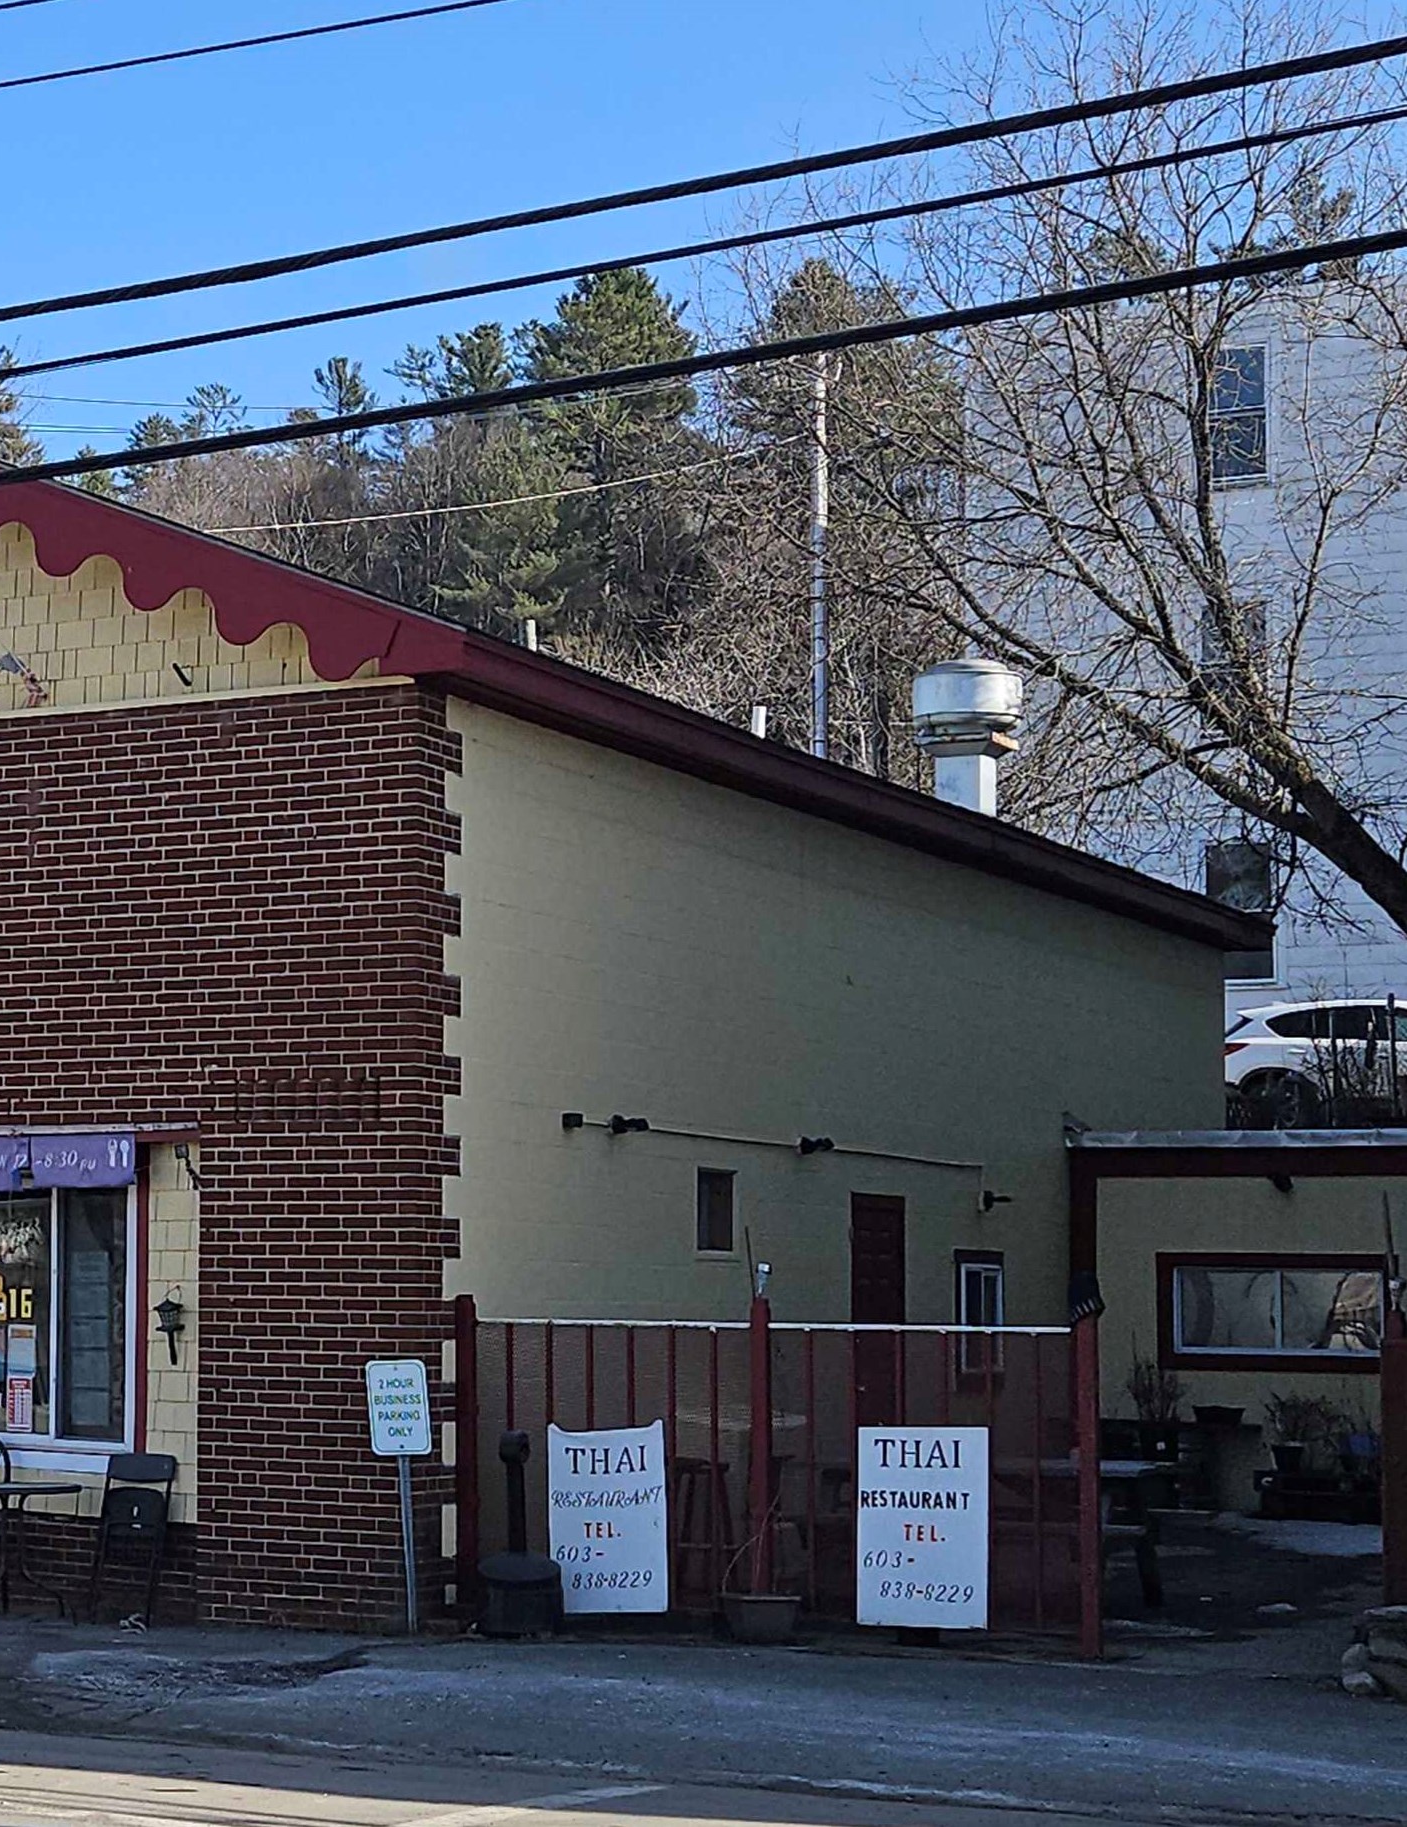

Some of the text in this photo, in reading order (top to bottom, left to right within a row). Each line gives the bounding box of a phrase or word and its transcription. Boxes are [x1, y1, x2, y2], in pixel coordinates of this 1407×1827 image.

[9, 1287, 33, 1319] 16
[378, 1378, 415, 1389] 2 HOUR
[374, 1394, 422, 1406] BUSINESS
[378, 1410, 421, 1421] PARKING
[388, 1425, 414, 1437] ONLY
[565, 1444, 648, 1475] THAI
[873, 1438, 962, 1469] THAI
[551, 1485, 663, 1509] RESTAURANT
[861, 1490, 970, 1511] RESTAURANT
[584, 1521, 622, 1539] TEL.
[904, 1523, 947, 1543] TEL.
[556, 1544, 605, 1563] 603-
[863, 1549, 915, 1569] 603-
[880, 1580, 974, 1604] 838-8229
